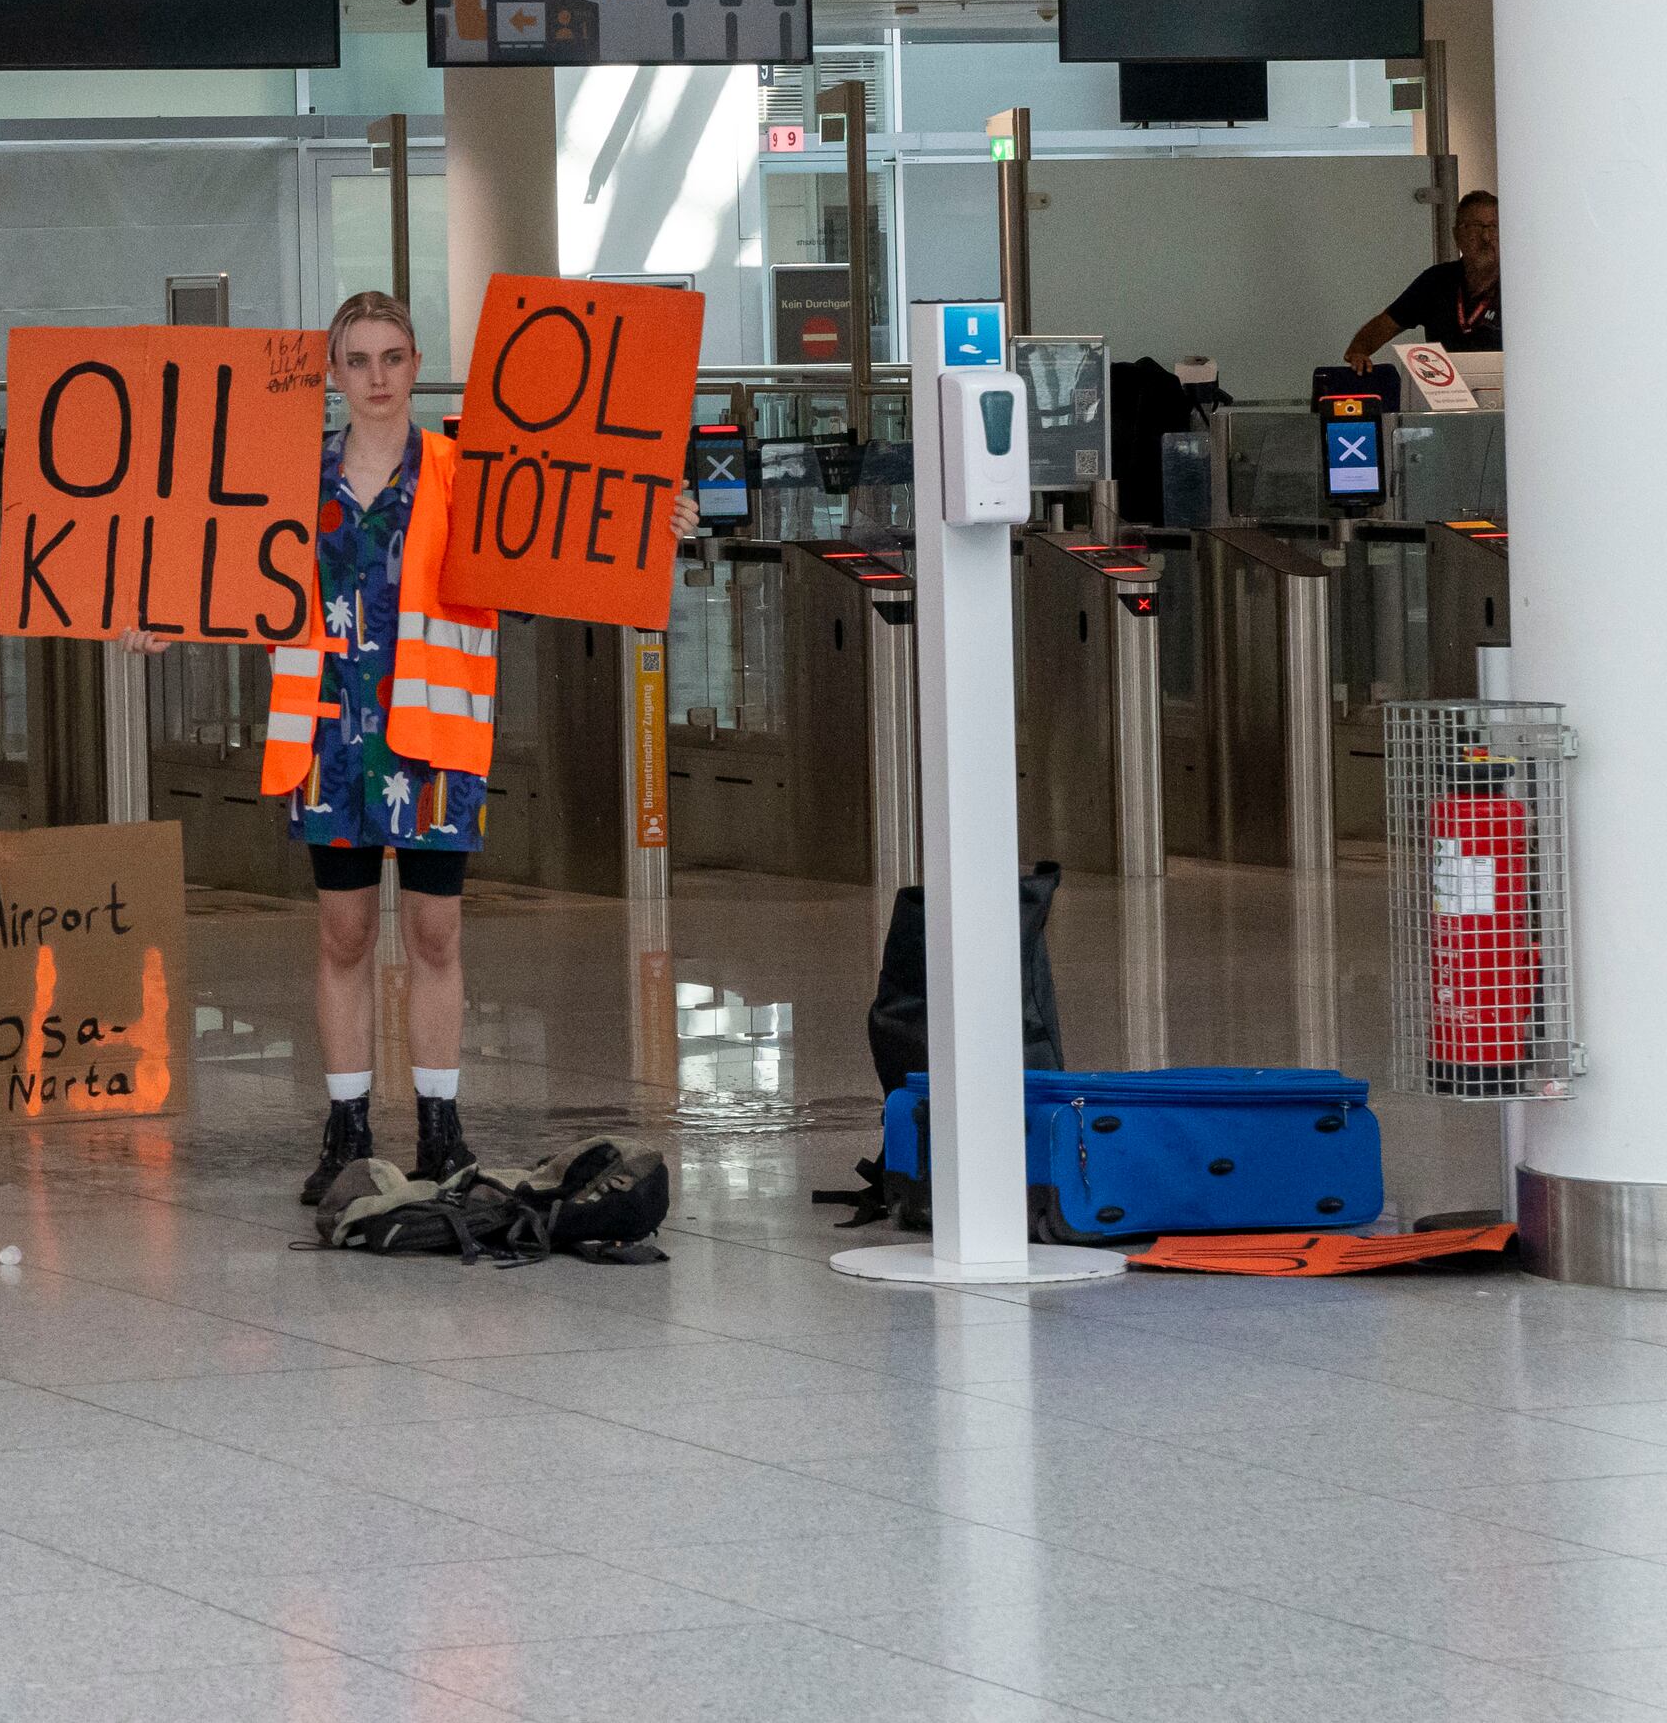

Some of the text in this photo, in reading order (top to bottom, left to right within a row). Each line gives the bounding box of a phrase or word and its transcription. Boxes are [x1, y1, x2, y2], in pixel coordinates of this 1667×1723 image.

[787, 131, 797, 147] 9
[263, 332, 304, 357] 161
[781, 299, 851, 311] Kein Durchgan
[492, 297, 662, 440] ÖL
[38, 360, 268, 507] OIL
[462, 445, 673, 570] TÖTET
[18, 513, 311, 641] KILLS
